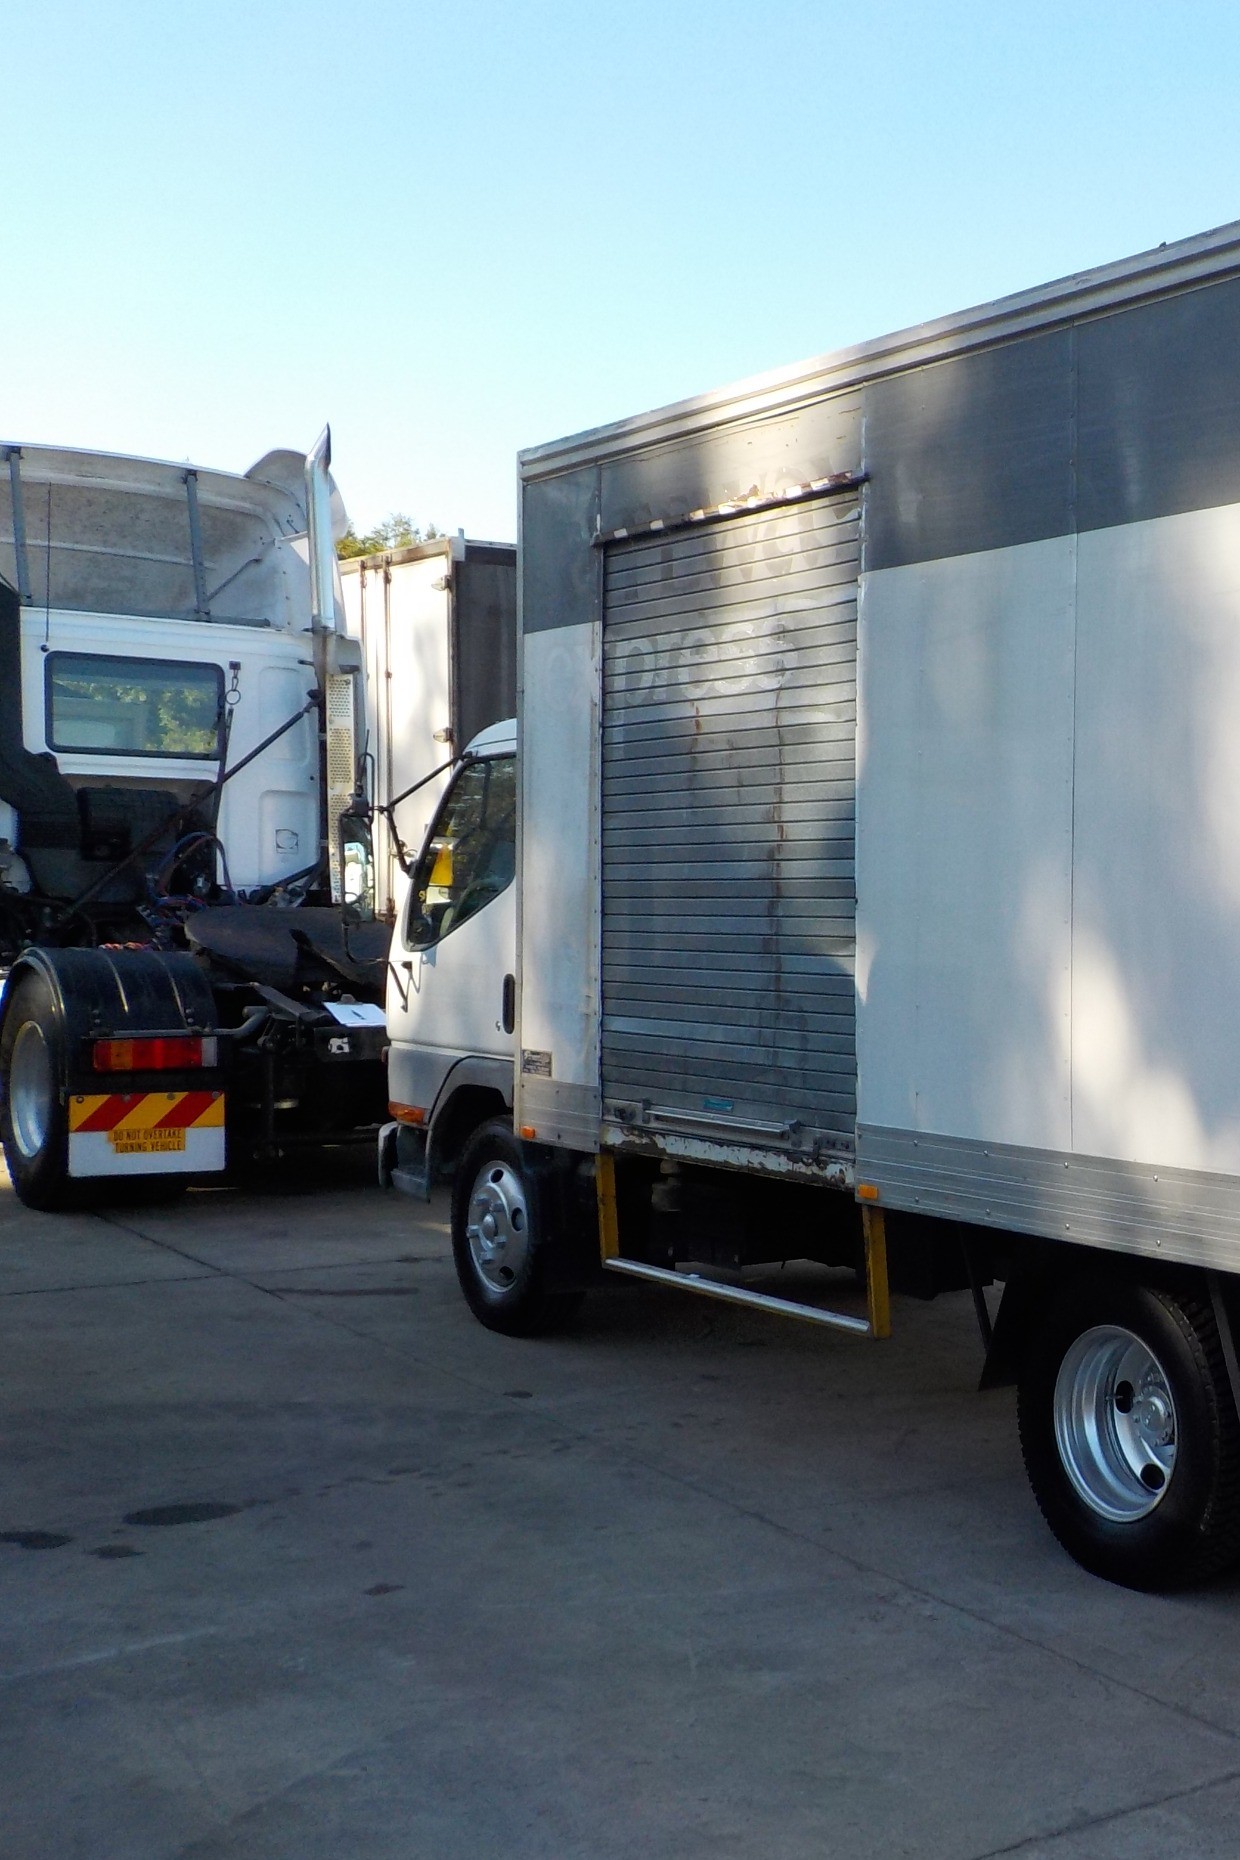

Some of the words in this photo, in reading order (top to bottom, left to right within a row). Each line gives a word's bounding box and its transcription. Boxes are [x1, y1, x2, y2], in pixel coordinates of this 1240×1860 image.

[113, 1129, 124, 1141] DO
[126, 1129, 140, 1141] NOT
[143, 1127, 182, 1140] OVERTAKE
